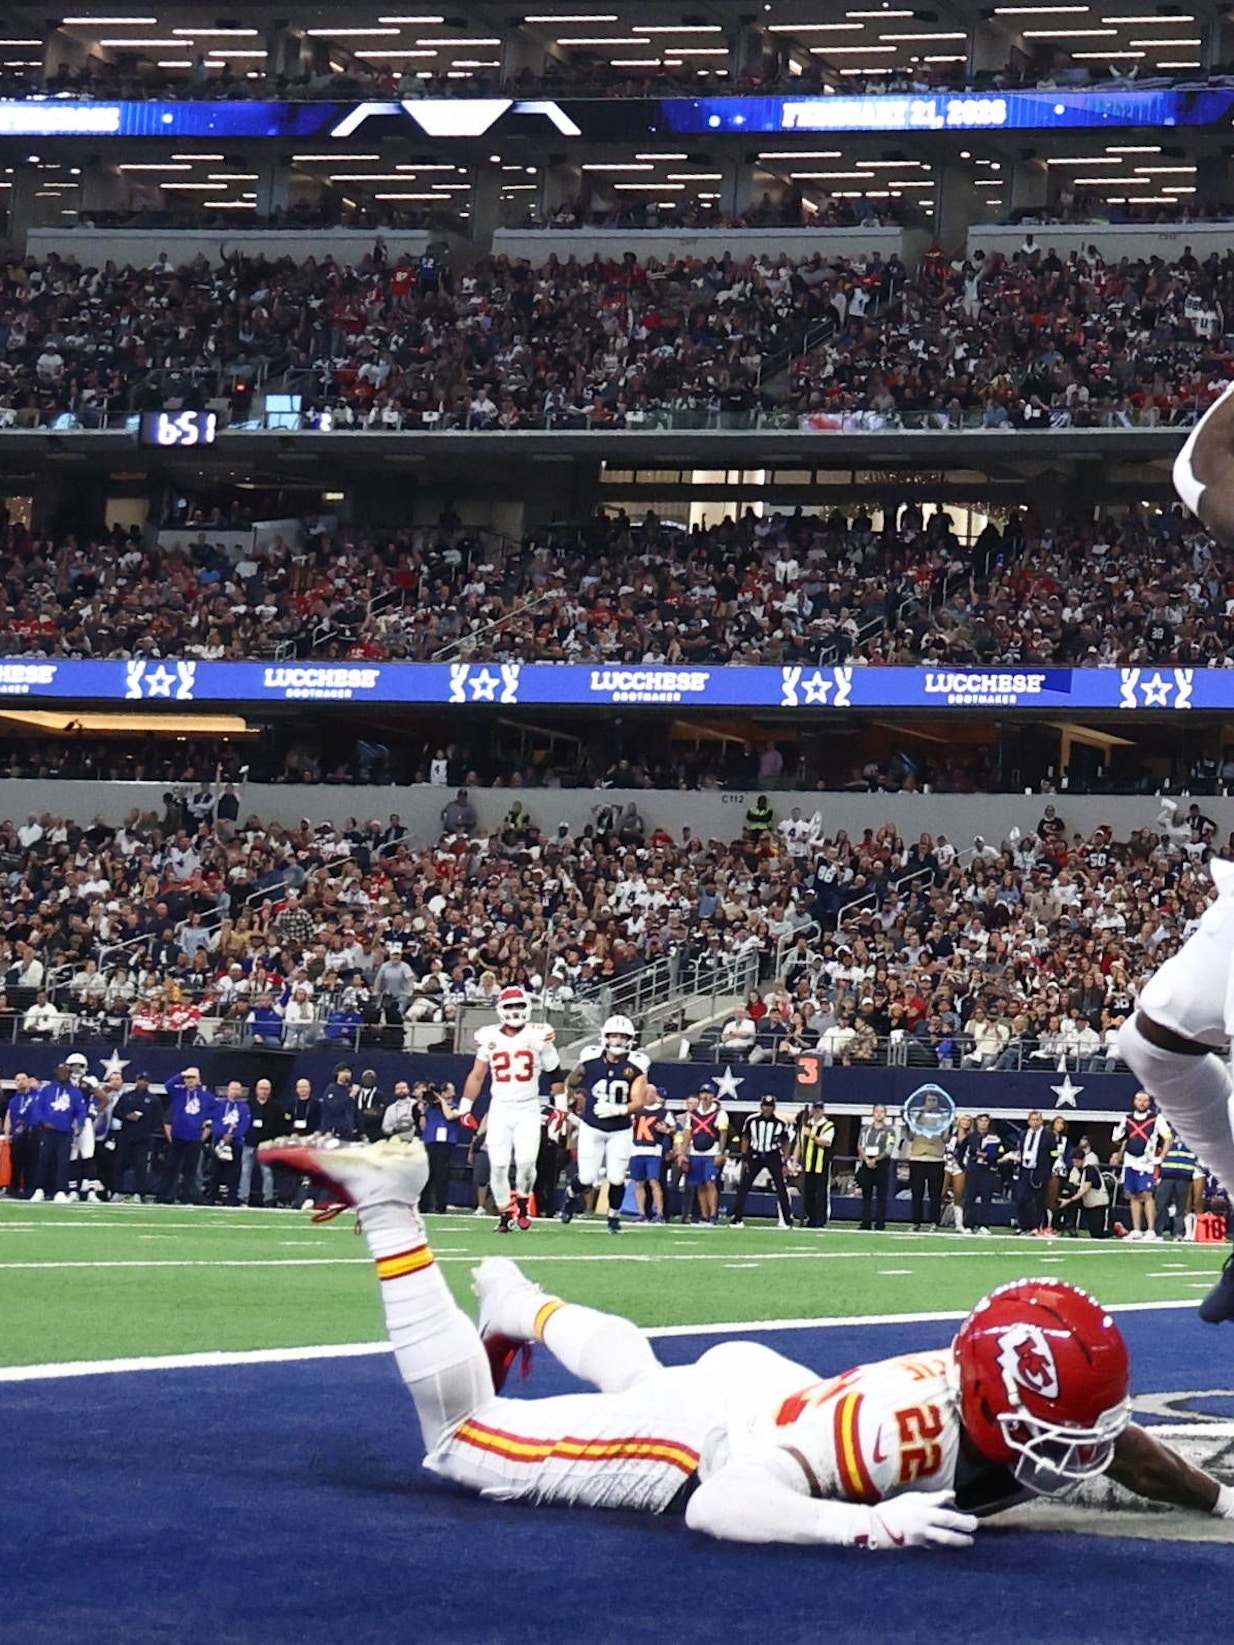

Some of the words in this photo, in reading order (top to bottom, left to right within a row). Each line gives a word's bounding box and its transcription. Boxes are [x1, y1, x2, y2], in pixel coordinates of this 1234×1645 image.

[264, 668, 376, 688] LUCCHESE
[590, 671, 706, 691] LUCCHESE
[925, 673, 1041, 693] LUCCHESE
[492, 1050, 534, 1082] 23
[797, 1057, 819, 1085] 3
[636, 1116, 658, 1141] K
[896, 1404, 944, 1486] 22
